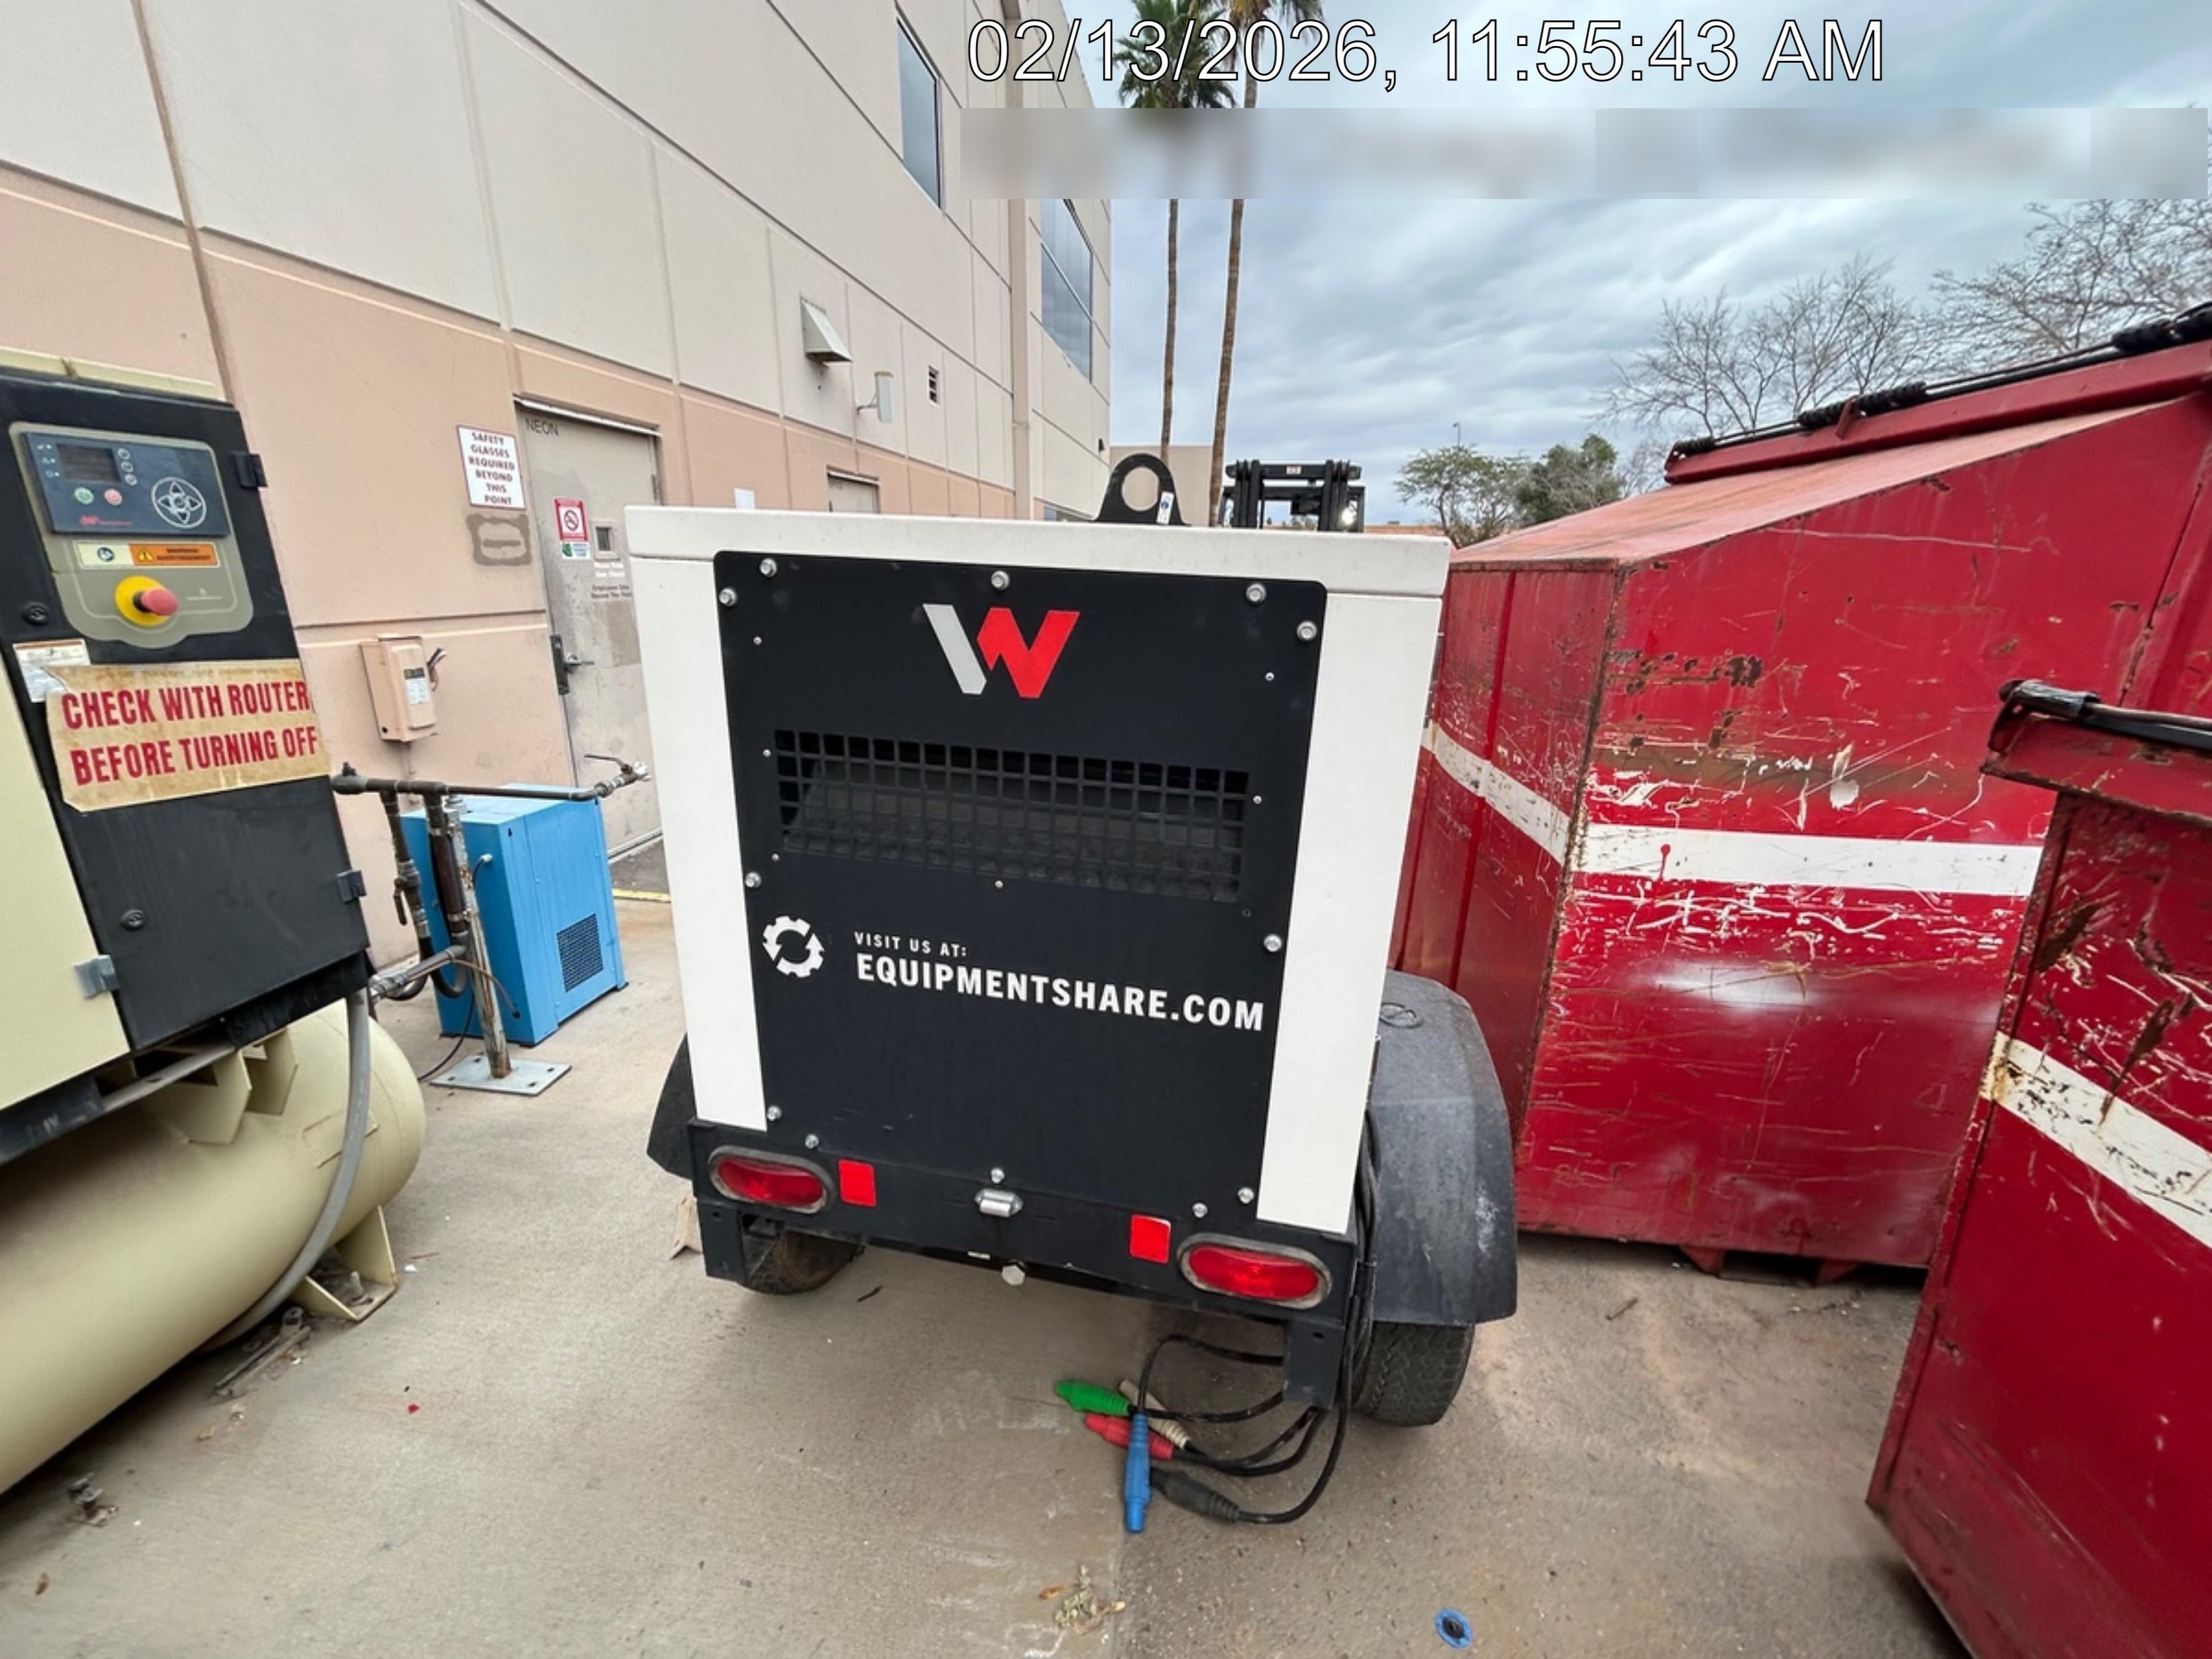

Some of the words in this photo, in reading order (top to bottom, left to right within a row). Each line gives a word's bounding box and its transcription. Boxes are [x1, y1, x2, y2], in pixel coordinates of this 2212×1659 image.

[525, 418, 560, 437] NEON
[471, 433, 504, 445] SAFETY
[471, 444, 509, 458] GLASSES
[468, 457, 515, 471] REQUIRED
[475, 469, 513, 482] BEYOND
[486, 483, 507, 493] THIS
[484, 495, 512, 505] POINT
[62, 688, 156, 729] CHECK
[159, 684, 224, 721] WITH
[226, 681, 311, 714] ROUTER
[70, 740, 176, 785] BEFORE
[178, 729, 279, 771] TURNING
[281, 725, 317, 758] OFF
[854, 931, 901, 950] VISIT
[909, 938, 931, 954] US
[939, 942, 967, 958] AT:
[856, 952, 1265, 1032] EQUIPMENTSHARE.COM
